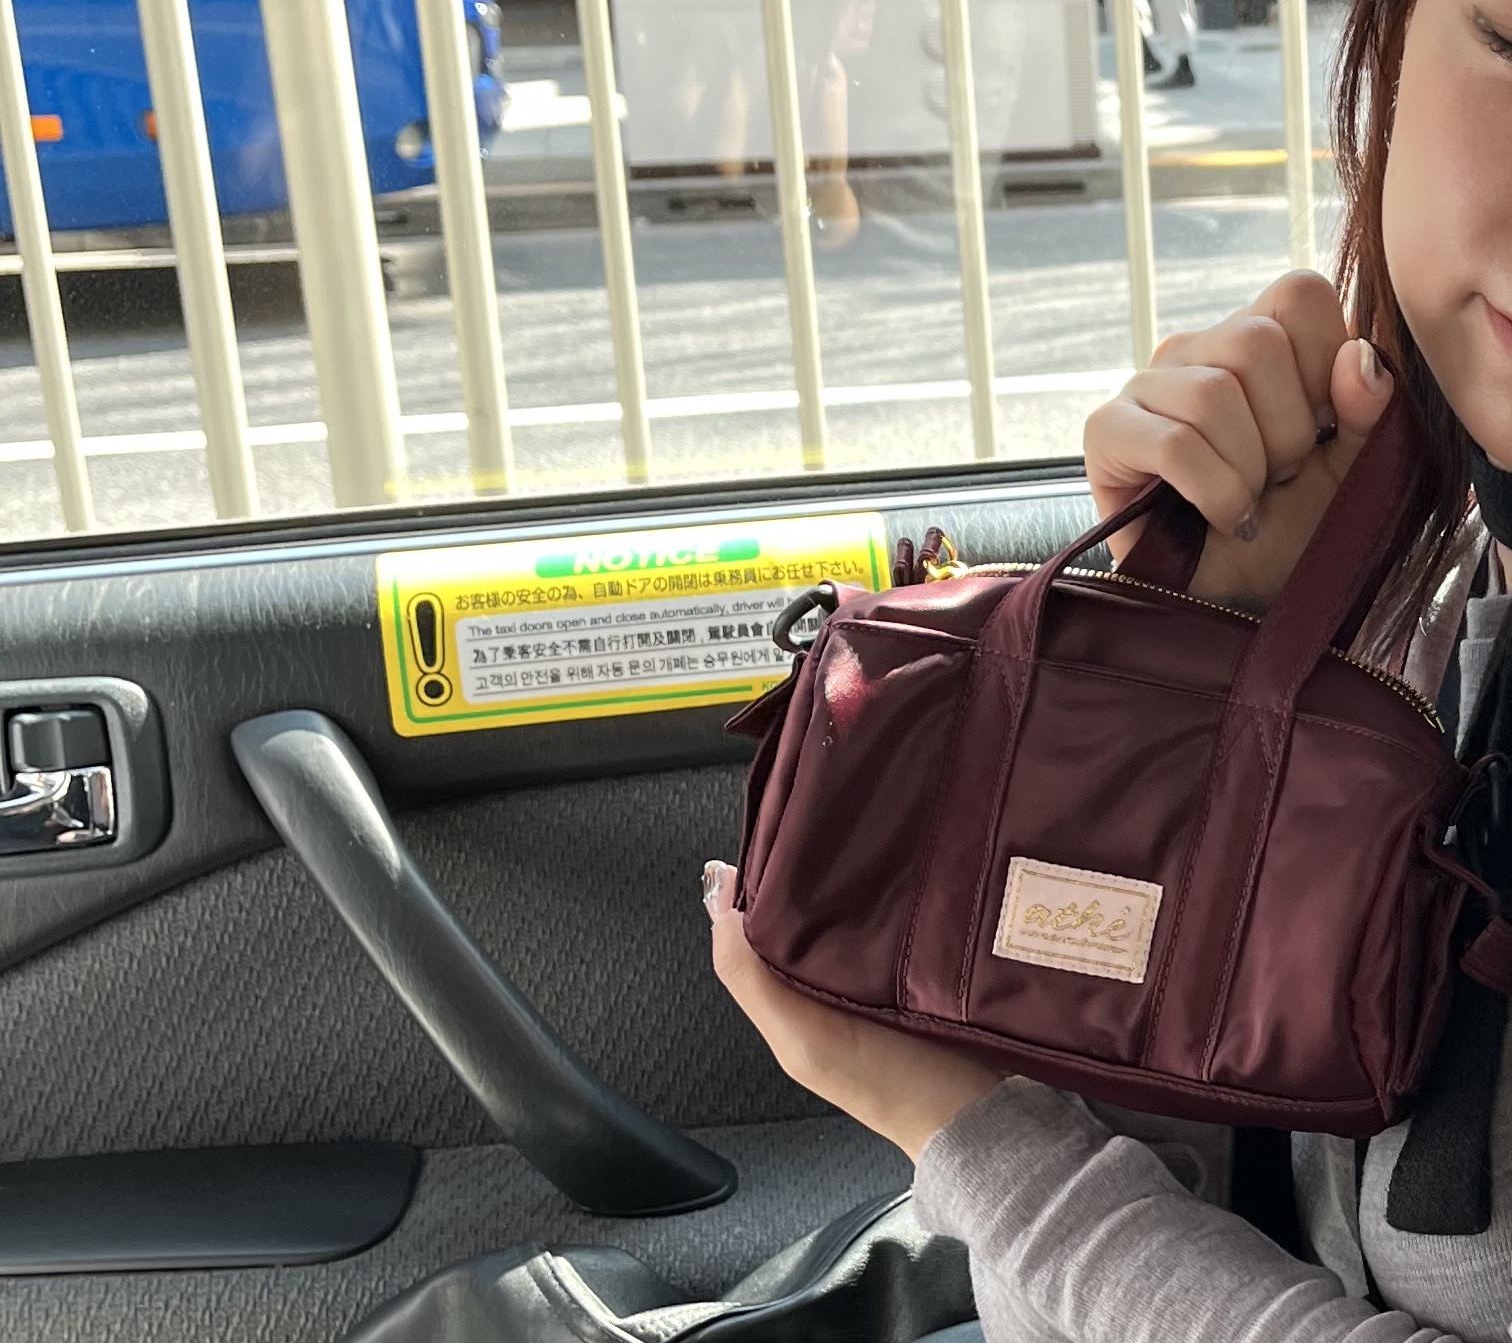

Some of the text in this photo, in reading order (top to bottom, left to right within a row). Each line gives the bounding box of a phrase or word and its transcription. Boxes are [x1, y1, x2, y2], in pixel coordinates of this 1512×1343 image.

[573, 539, 720, 574] NOTICE
[469, 625, 493, 637] The
[496, 622, 517, 635] taxi
[520, 620, 553, 632] doors
[556, 618, 587, 632] open
[590, 613, 612, 626] and
[616, 612, 647, 624] close
[650, 603, 730, 620] automatically,
[732, 601, 765, 613] driver
[767, 597, 785, 608] will
[475, 671, 518, 691] 고객의
[520, 667, 562, 686] 안전을
[566, 663, 594, 681] 위해
[703, 647, 770, 669] 승무원에게
